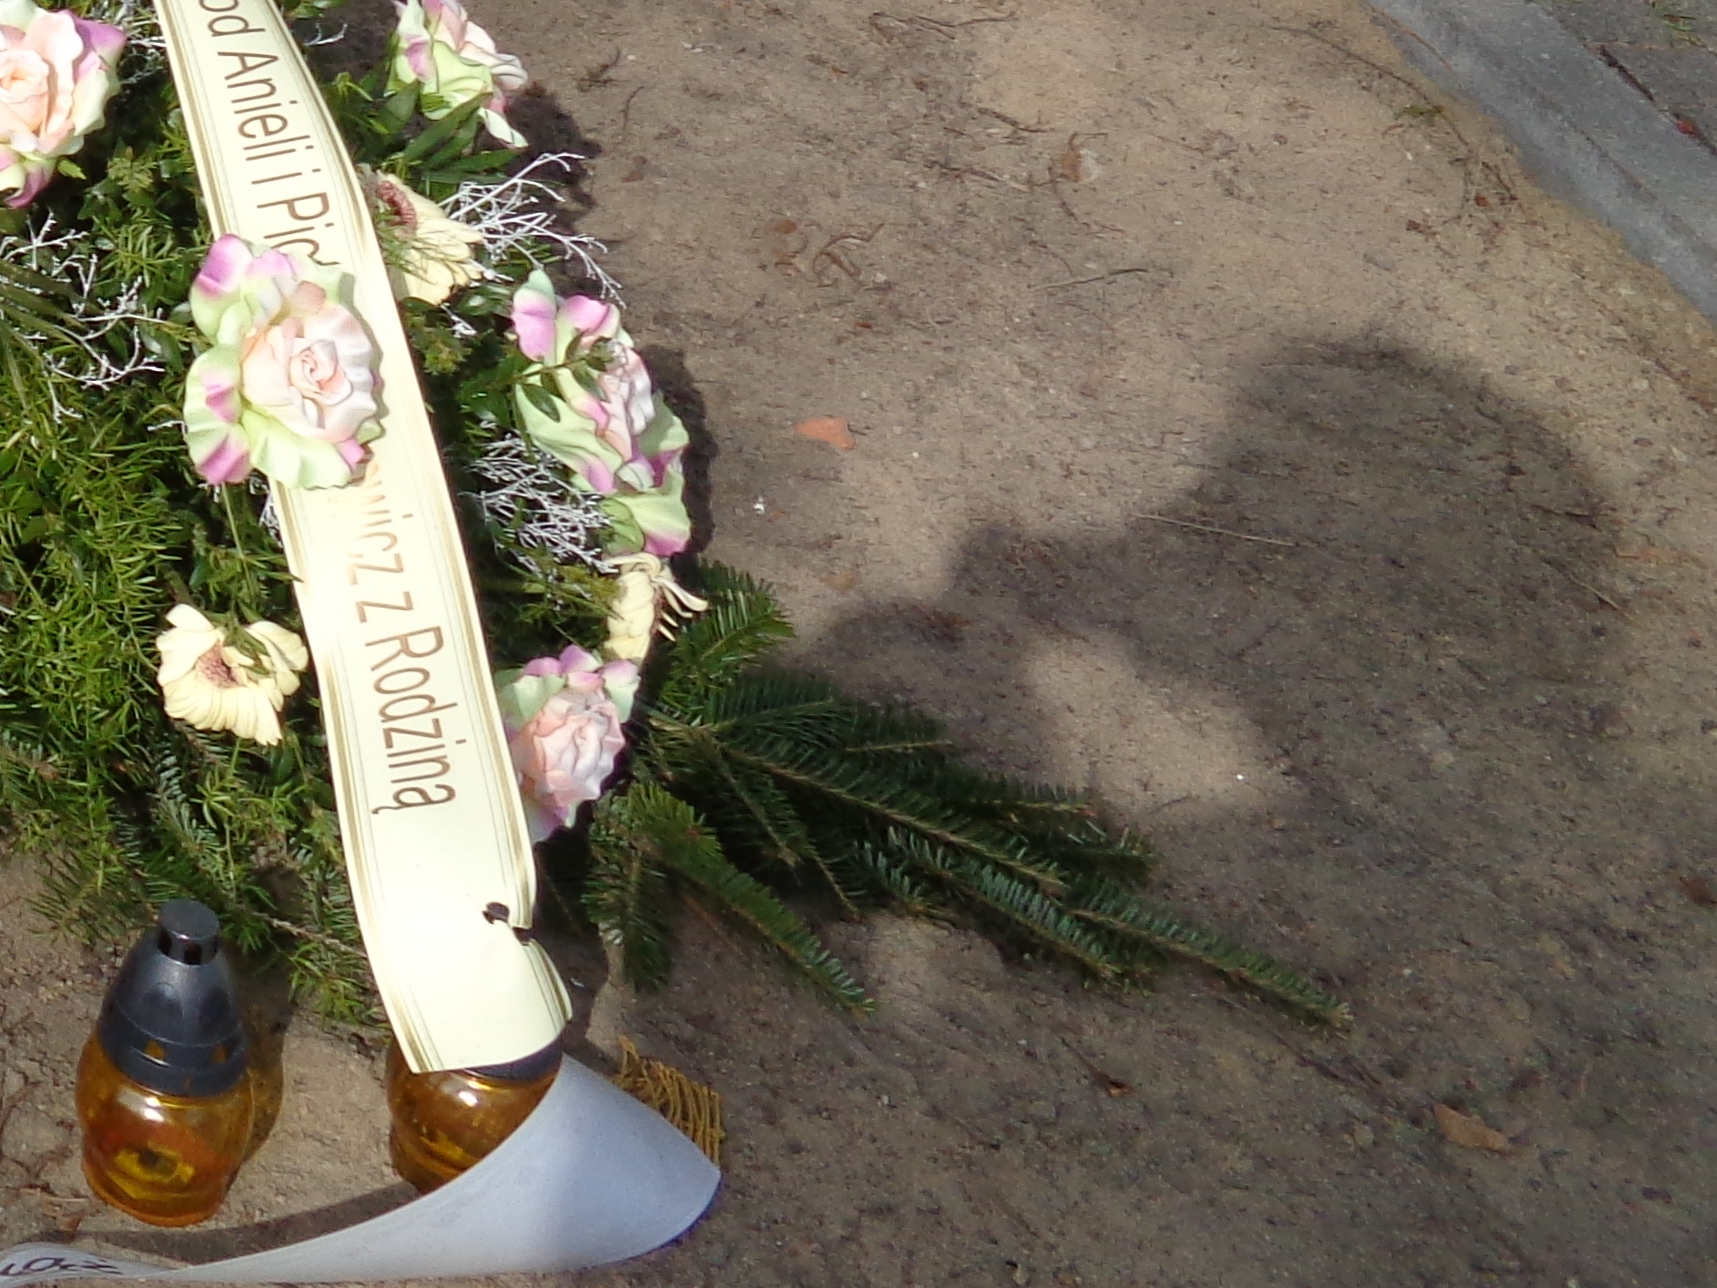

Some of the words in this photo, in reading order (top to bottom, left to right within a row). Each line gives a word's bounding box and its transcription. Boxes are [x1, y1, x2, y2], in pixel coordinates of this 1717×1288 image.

[217, 50, 315, 162] Anieli
[250, 167, 322, 185] i
[355, 590, 414, 624] z
[364, 626, 467, 815] Rodziną
